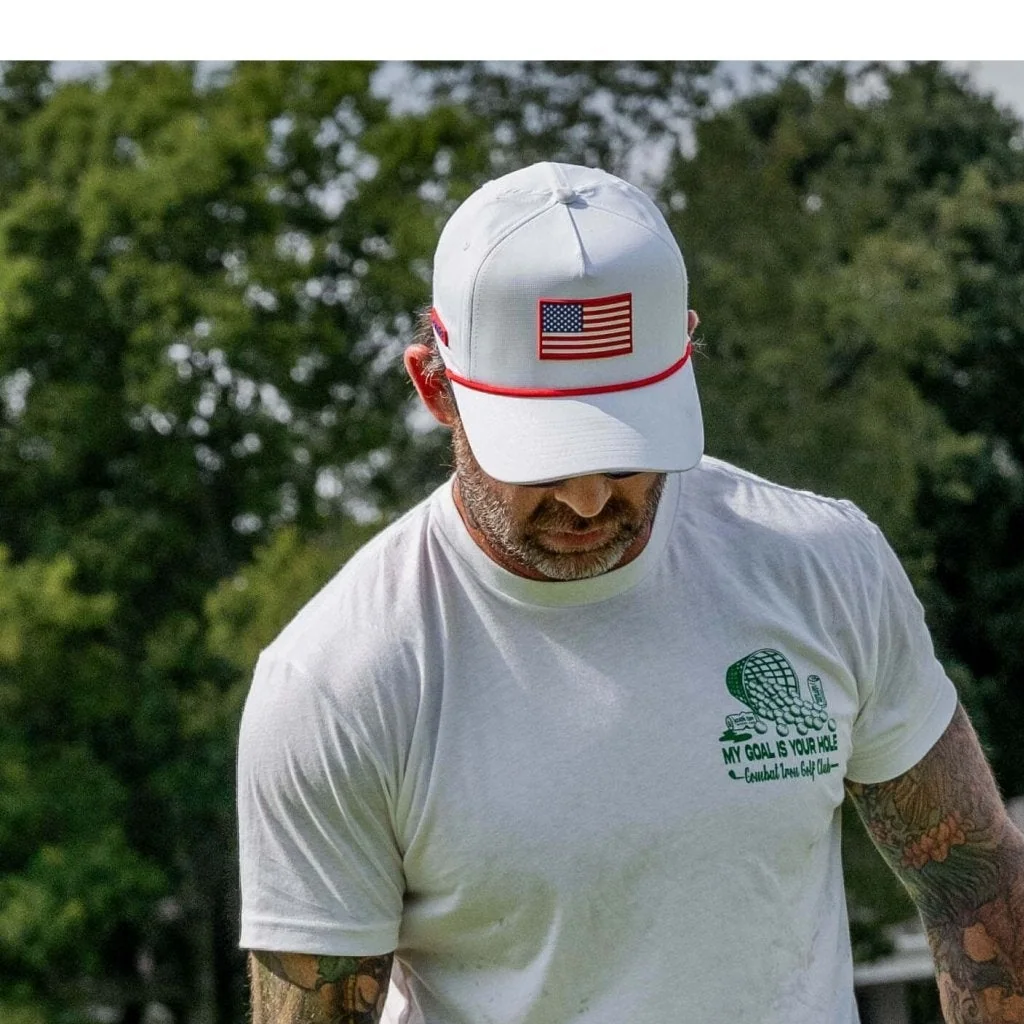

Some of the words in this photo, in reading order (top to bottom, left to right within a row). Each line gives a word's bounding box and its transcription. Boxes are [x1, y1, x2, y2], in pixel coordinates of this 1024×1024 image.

[722, 745, 741, 765] MY
[745, 742, 775, 761] GOAL
[776, 740, 788, 758] IS
[788, 737, 817, 756] YOUR
[817, 734, 838, 753] HOLE
[745, 764, 780, 783] Combat
[780, 763, 799, 779] Iron
[800, 760, 816, 782] Golf
[817, 757, 831, 774] Club
